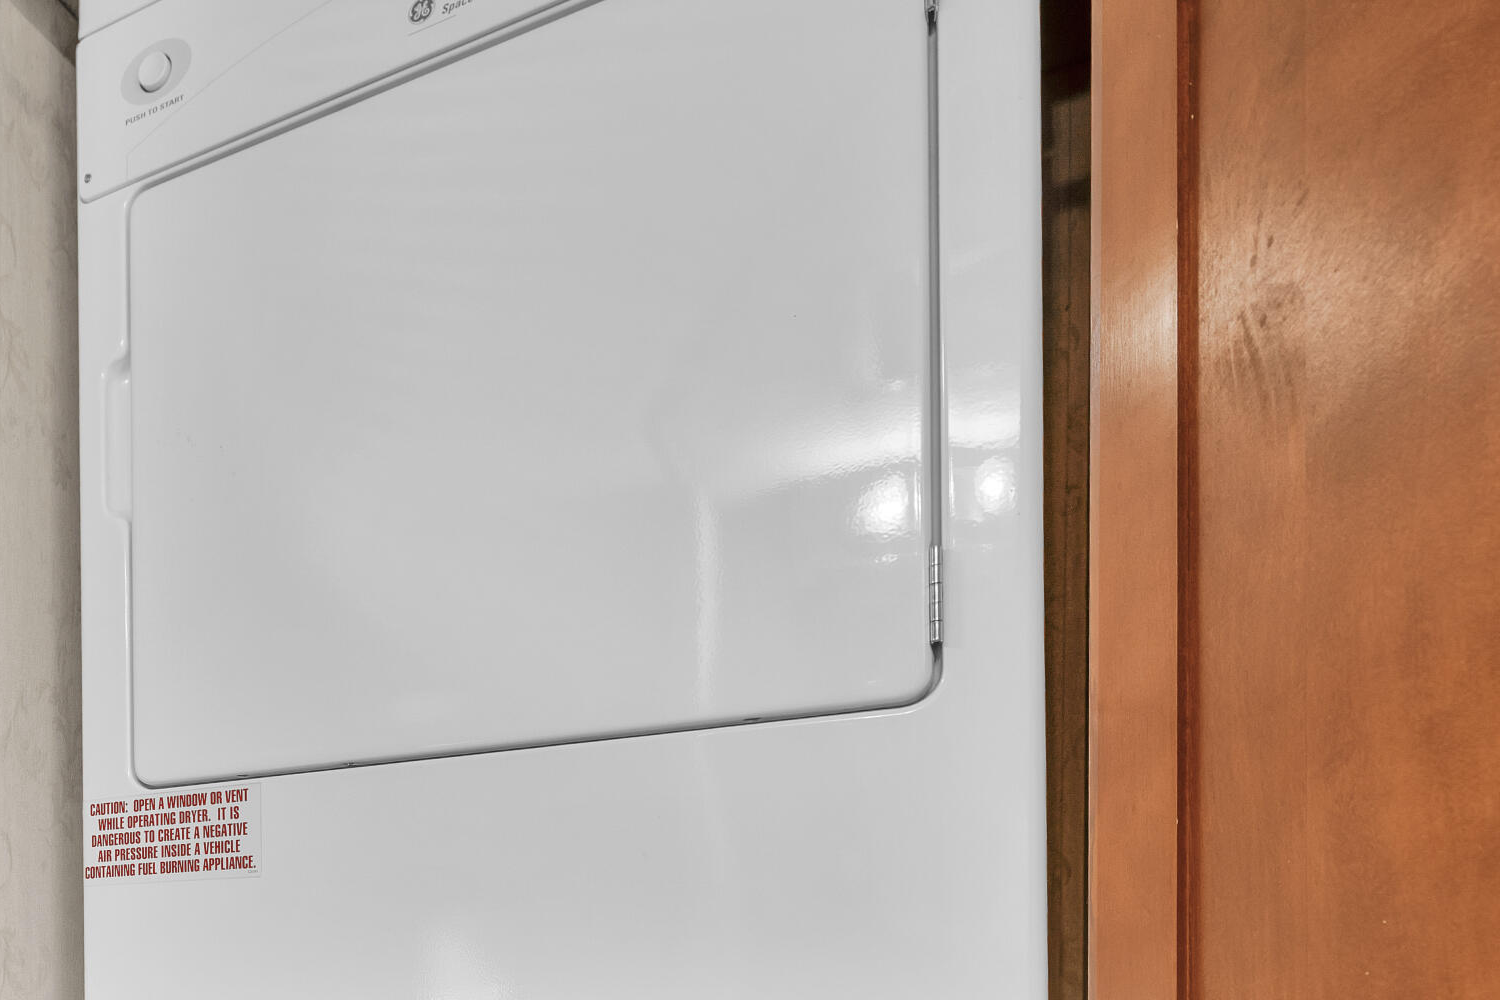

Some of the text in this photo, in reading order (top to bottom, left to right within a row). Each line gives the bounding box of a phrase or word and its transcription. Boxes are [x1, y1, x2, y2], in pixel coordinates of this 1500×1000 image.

[125, 94, 184, 126] PUSH TO START
[90, 788, 249, 816] CAUTION: OPEN A WINDOW OR VENT
[98, 806, 240, 831] WHILE OPERATING DRYER. IT IS
[91, 822, 248, 848] DANGEROUS TO CREATE A NEGATIVE
[98, 839, 241, 862] AIR PRESSURE INSIDE A VEHICLE
[85, 855, 256, 879] CONTAINING FUEL BURNING APPLIANCE.
